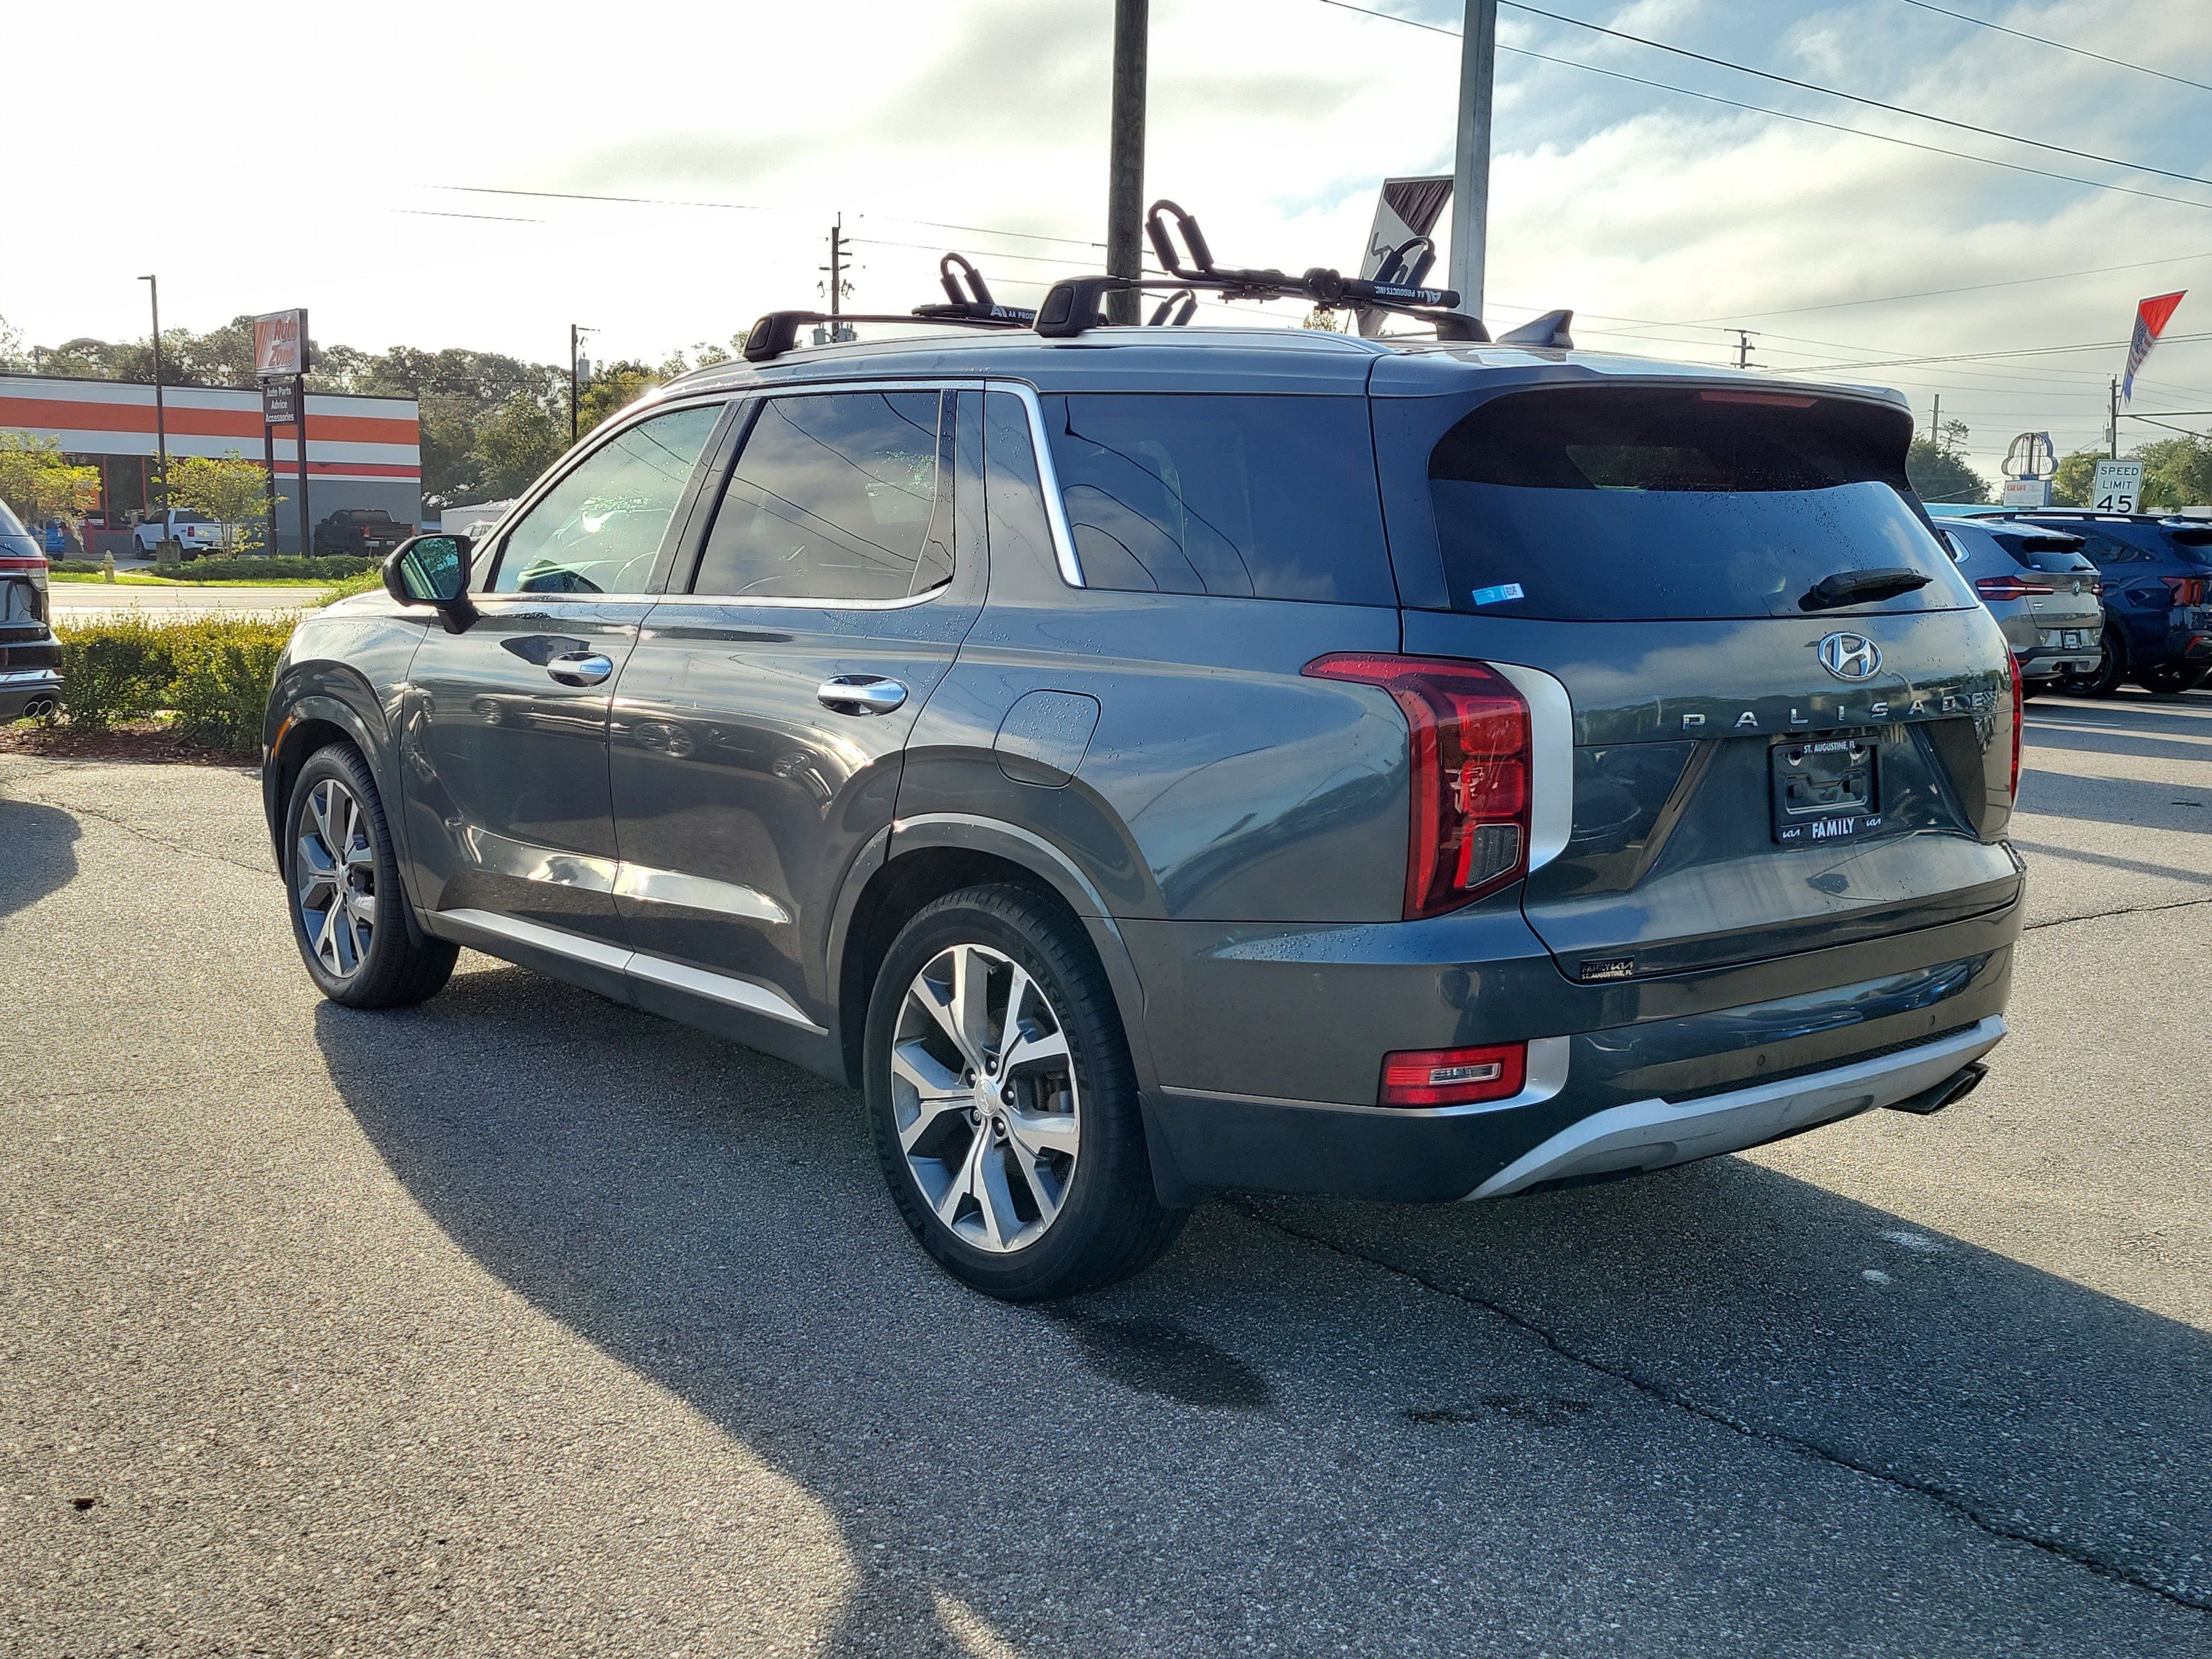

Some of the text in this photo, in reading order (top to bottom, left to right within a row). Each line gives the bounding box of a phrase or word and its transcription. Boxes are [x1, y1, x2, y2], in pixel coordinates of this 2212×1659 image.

[1386, 286, 1415, 297] PRODUCTS
[268, 344, 295, 368] Zone
[267, 386, 292, 397] Auto Parts
[270, 399, 288, 410] Advice
[266, 411, 295, 422] Accessories
[2100, 466, 2139, 476] SPEED
[2102, 480, 2133, 490] LIMIT
[2097, 494, 2132, 514] 45
[1682, 692, 1985, 731] PALISADE
[1804, 740, 1855, 754] ST. AUGUSTINE, FL
[1812, 818, 1854, 839] FAMILY
[1582, 963, 1610, 973] FAMILY
